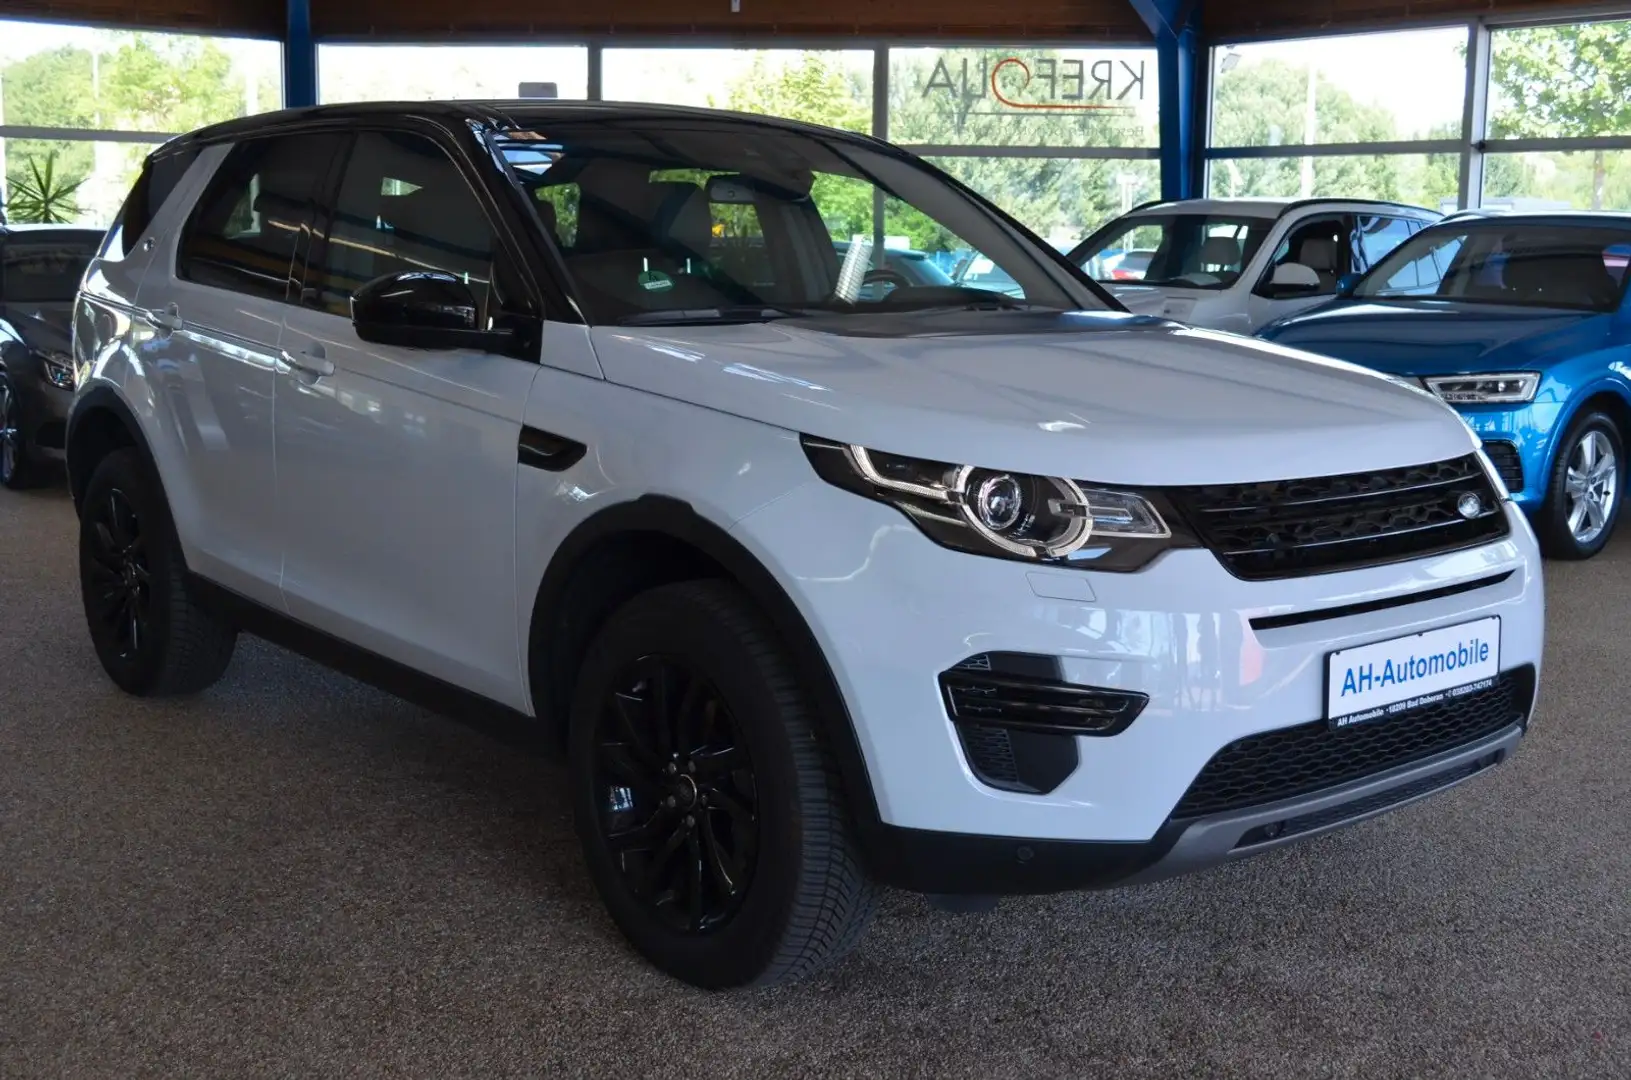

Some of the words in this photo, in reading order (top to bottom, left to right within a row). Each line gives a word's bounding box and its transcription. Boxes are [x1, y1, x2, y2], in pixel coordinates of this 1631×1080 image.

[1341, 638, 1489, 697] AH-Automobile
[1337, 716, 1348, 727] AH
[1349, 708, 1384, 723] Automobile
[1407, 699, 1419, 708] Bad
